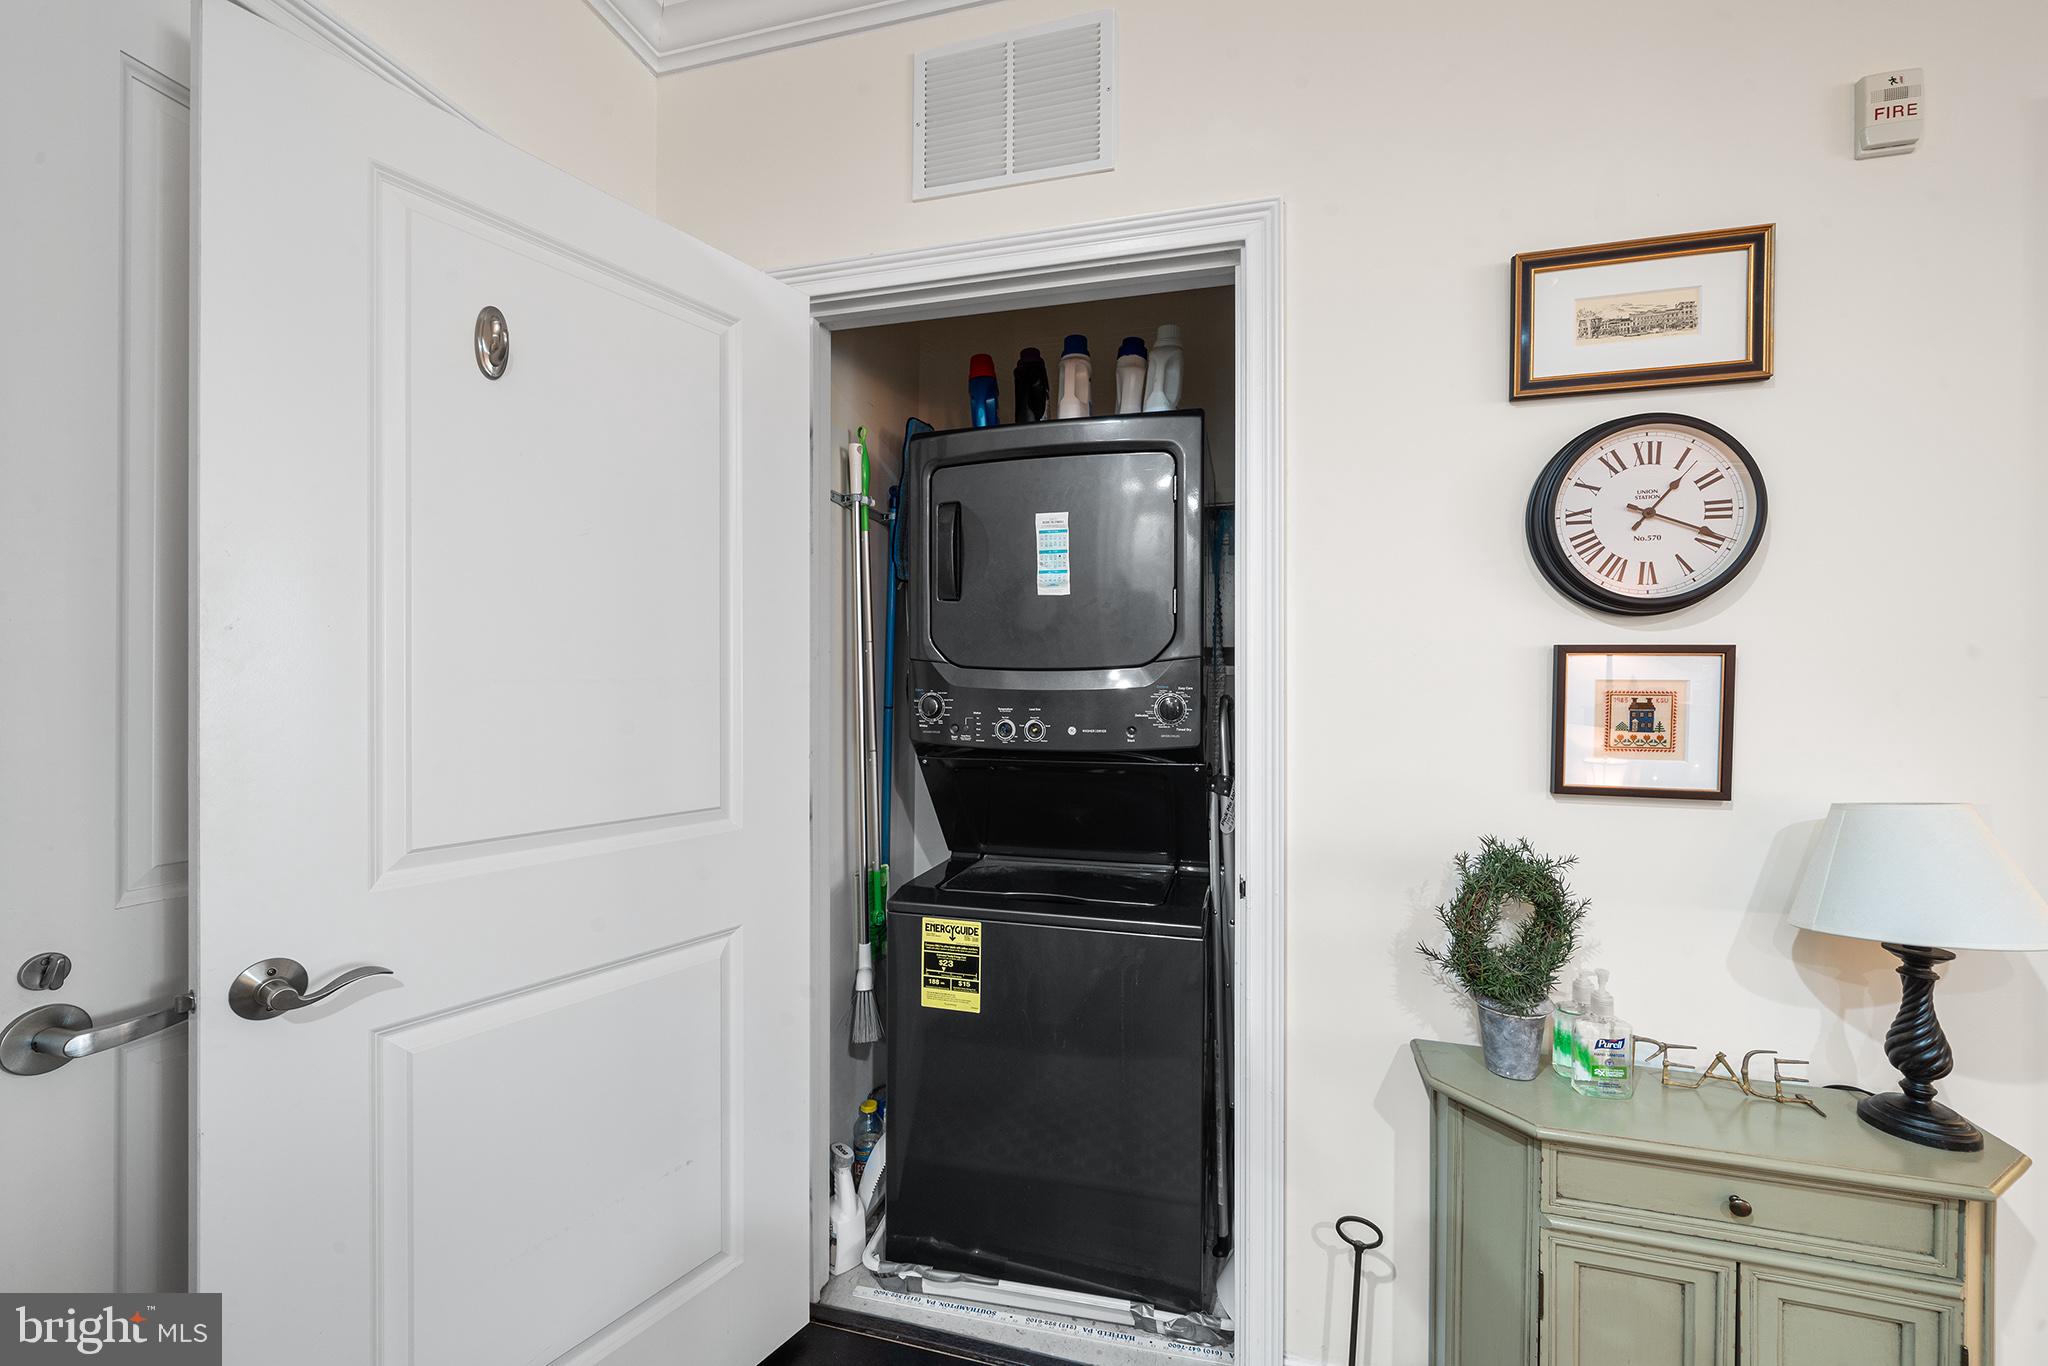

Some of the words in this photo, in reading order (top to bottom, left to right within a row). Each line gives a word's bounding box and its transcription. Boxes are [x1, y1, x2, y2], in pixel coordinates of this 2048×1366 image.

[1874, 103, 1918, 121] FIRE
[1632, 441, 1663, 467] XII
[925, 922, 979, 937] ENERGYGUIDE
[938, 959, 954, 968] $23
[1598, 1039, 1623, 1049] Purell
[1632, 1034, 1826, 1118] PEACE
[1082, 1326, 1093, 1334] PA
